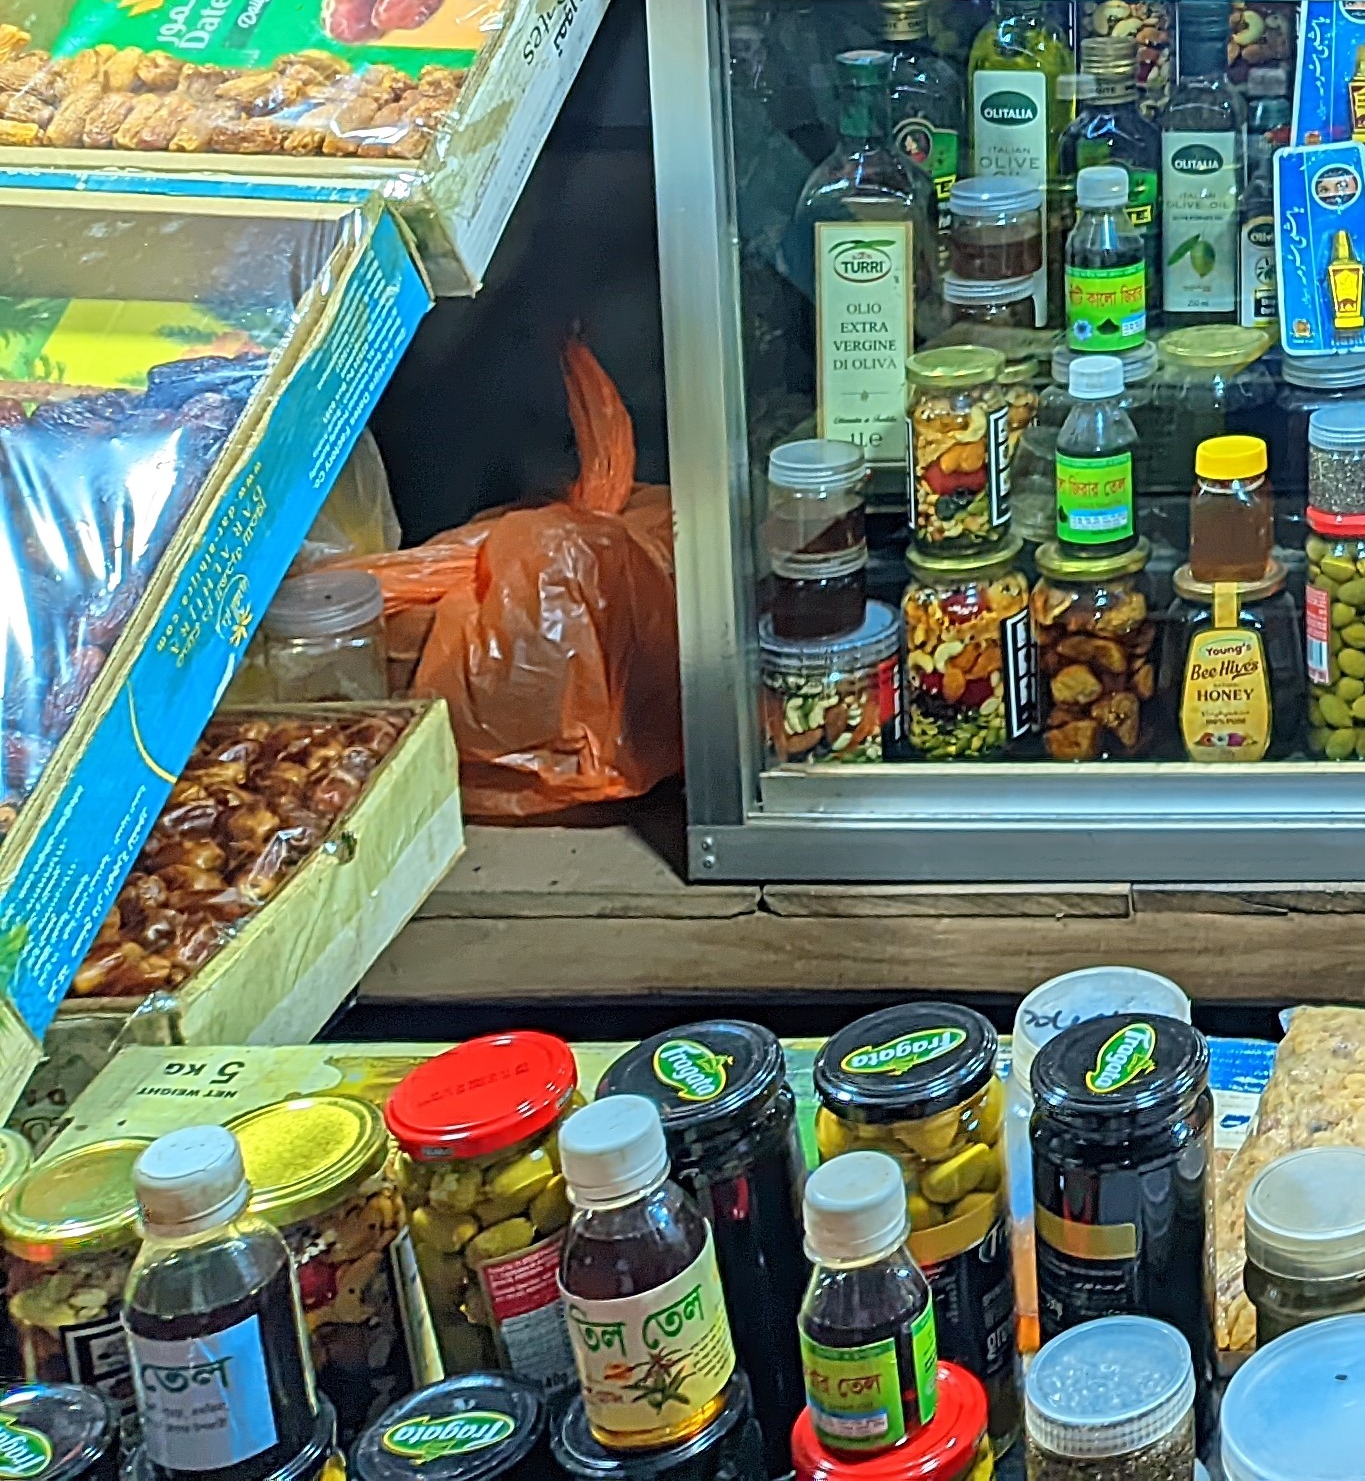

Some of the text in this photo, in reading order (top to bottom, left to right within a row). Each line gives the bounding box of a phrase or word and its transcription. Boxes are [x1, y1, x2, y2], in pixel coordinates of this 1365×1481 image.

[984, 106, 1034, 120] OLITALIA
[986, 146, 1030, 155] ITALIAN
[979, 156, 1040, 171] OLIVE
[1174, 159, 1219, 170] OLITALIA
[841, 260, 884, 276] TURRI
[1086, 291, 1117, 307] কালো
[846, 302, 882, 316] OLIO
[840, 322, 888, 335] EXTRA
[833, 340, 896, 353] VERGINE
[833, 357, 897, 371] DI OLIVA
[1104, 477, 1126, 496] তেল
[1204, 641, 1253, 658] Young's
[1196, 688, 1255, 704] HONEY
[849, 1031, 956, 1069] Fragata
[1094, 1027, 1145, 1092] Fragata
[164, 1061, 246, 1084] 5 KG
[663, 1042, 715, 1099] Fragata
[136, 1086, 238, 1099] NET WEIGHT
[642, 1283, 706, 1351] তেল
[394, 1413, 504, 1445] Fragata
